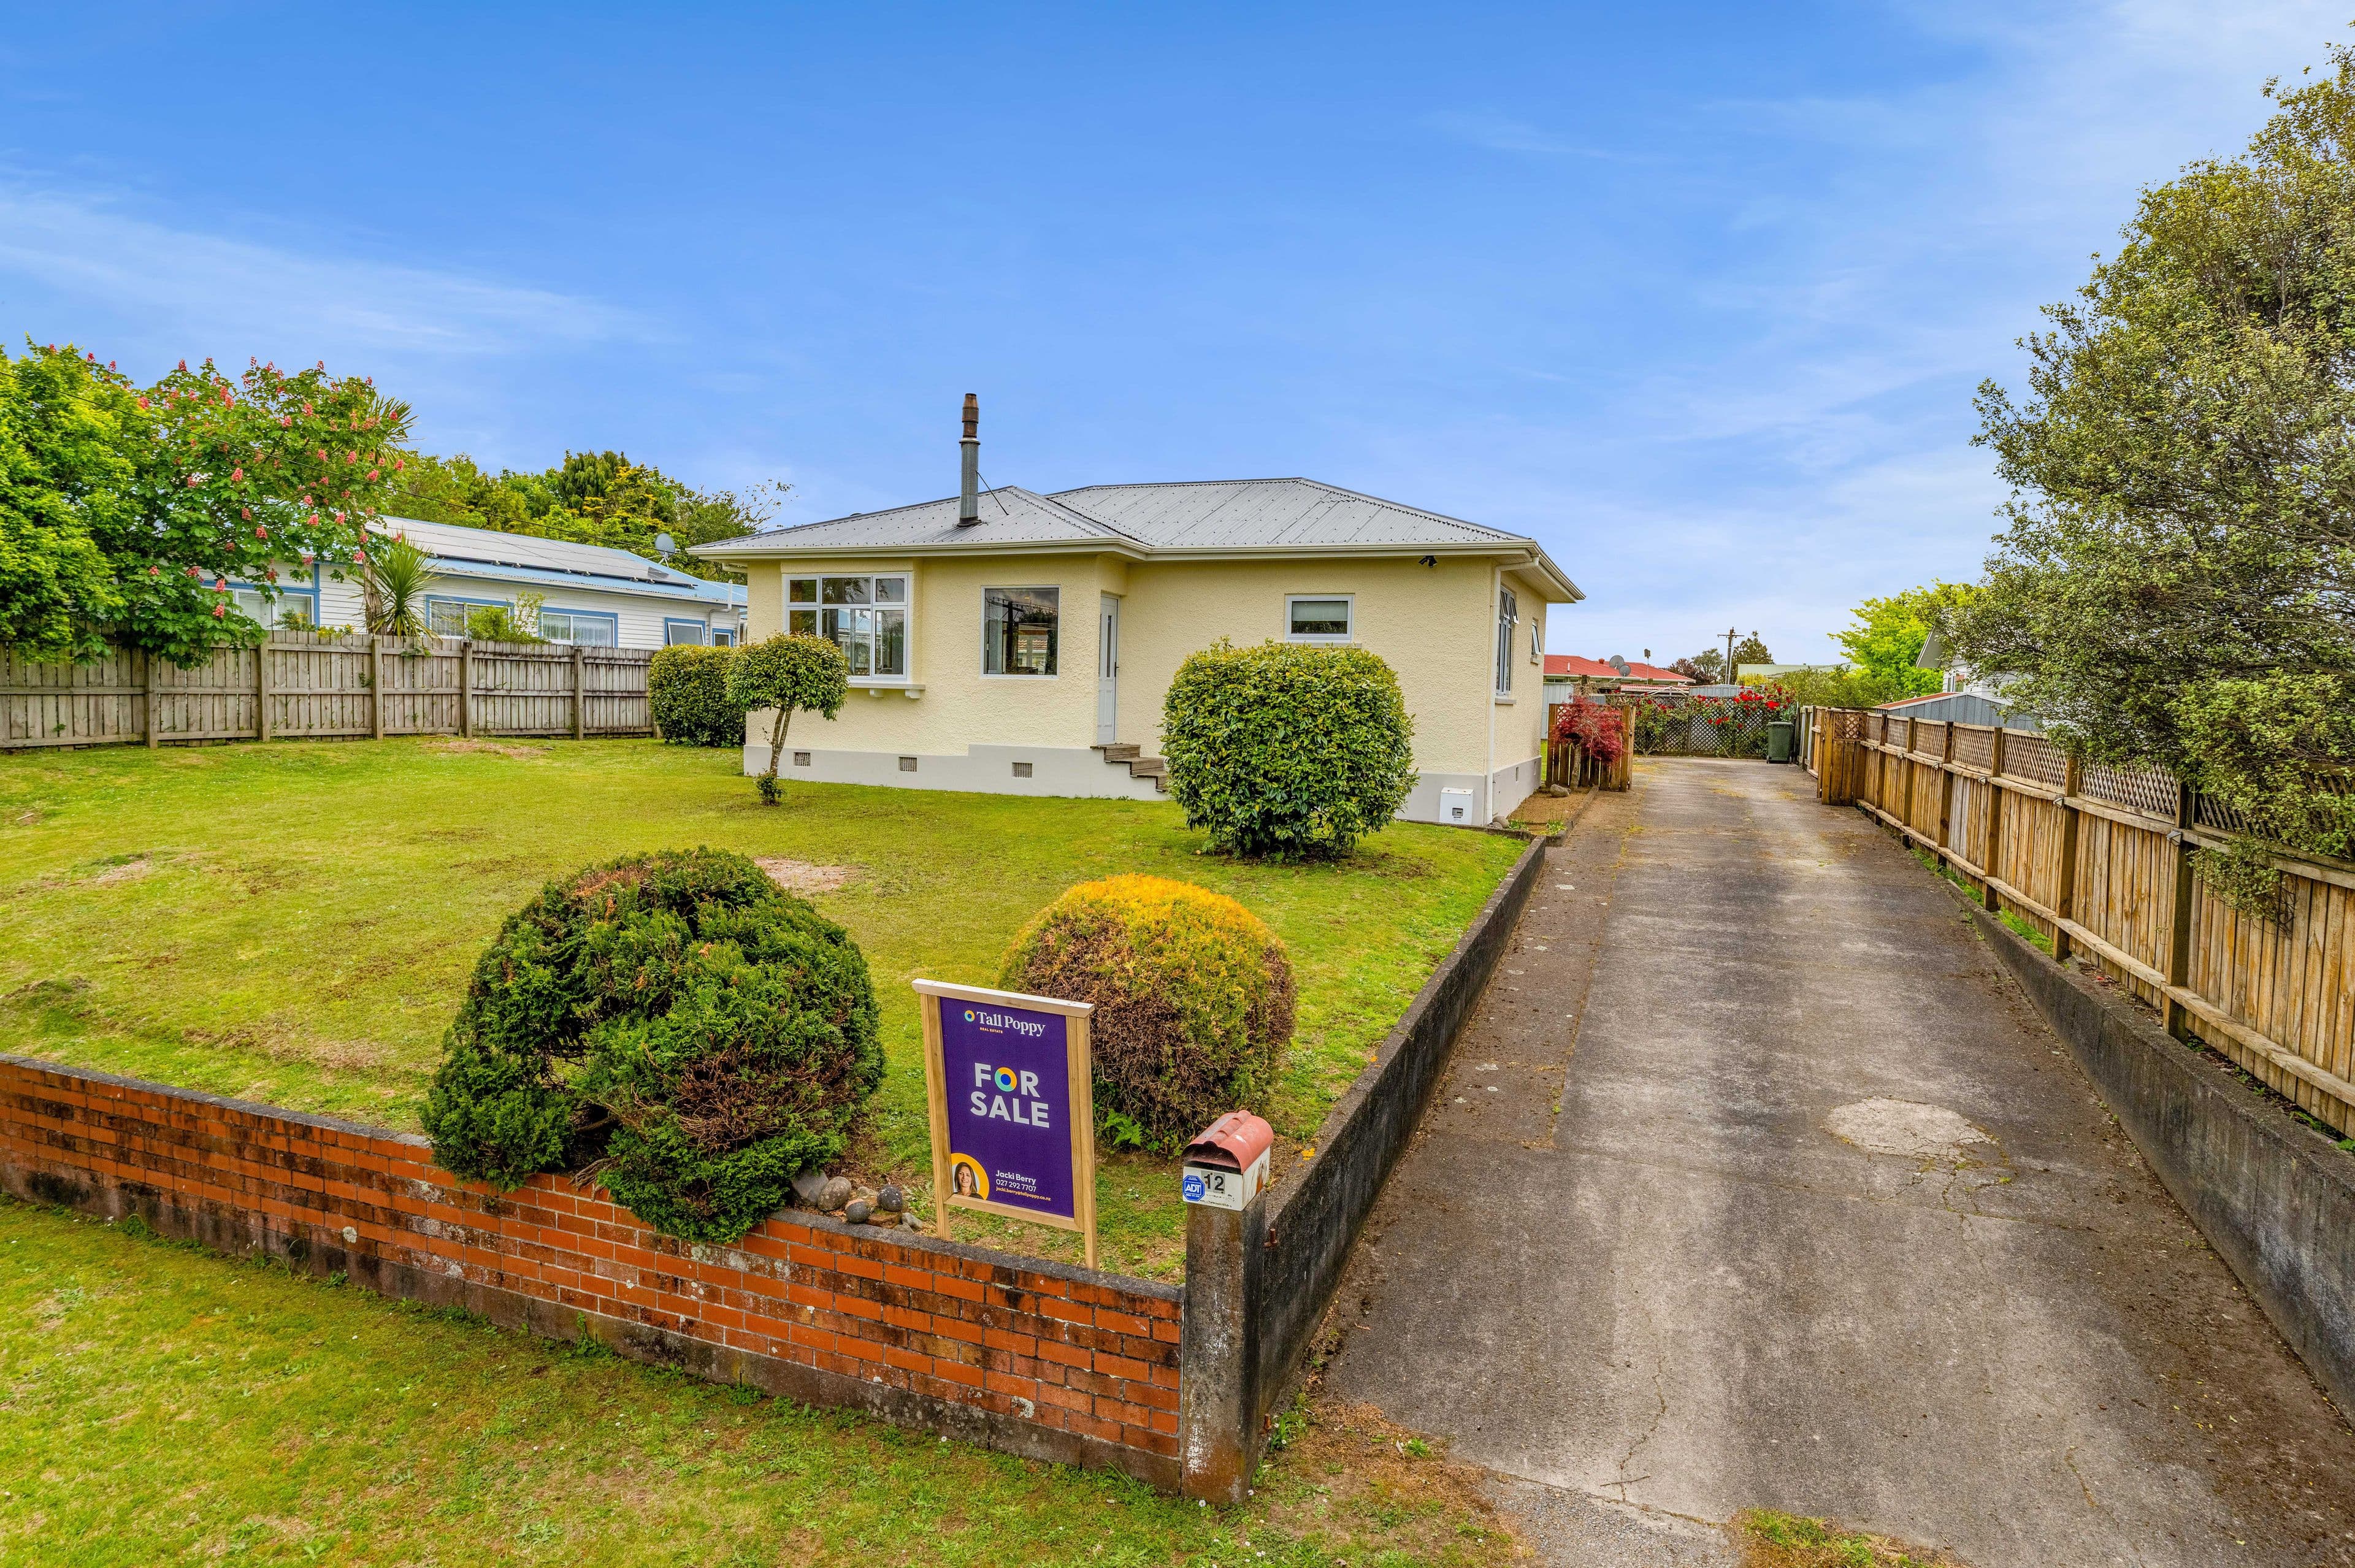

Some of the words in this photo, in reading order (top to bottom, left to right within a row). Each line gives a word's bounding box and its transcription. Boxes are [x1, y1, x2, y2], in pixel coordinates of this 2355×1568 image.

[976, 1011, 1003, 1027] Tall
[1004, 1015, 1046, 1037] Poppy
[975, 1062, 1041, 1098] FOR
[970, 1091, 1049, 1128] SALE
[995, 1170, 1014, 1180] Jacki
[1016, 1173, 1036, 1185] Berry
[1204, 1174, 1224, 1191] 12
[995, 1186, 1051, 1201] jacki.berry@tallpoppy.co.nz
[1021, 1184, 1036, 1192] 7707
[1185, 1183, 1201, 1193] ADT
